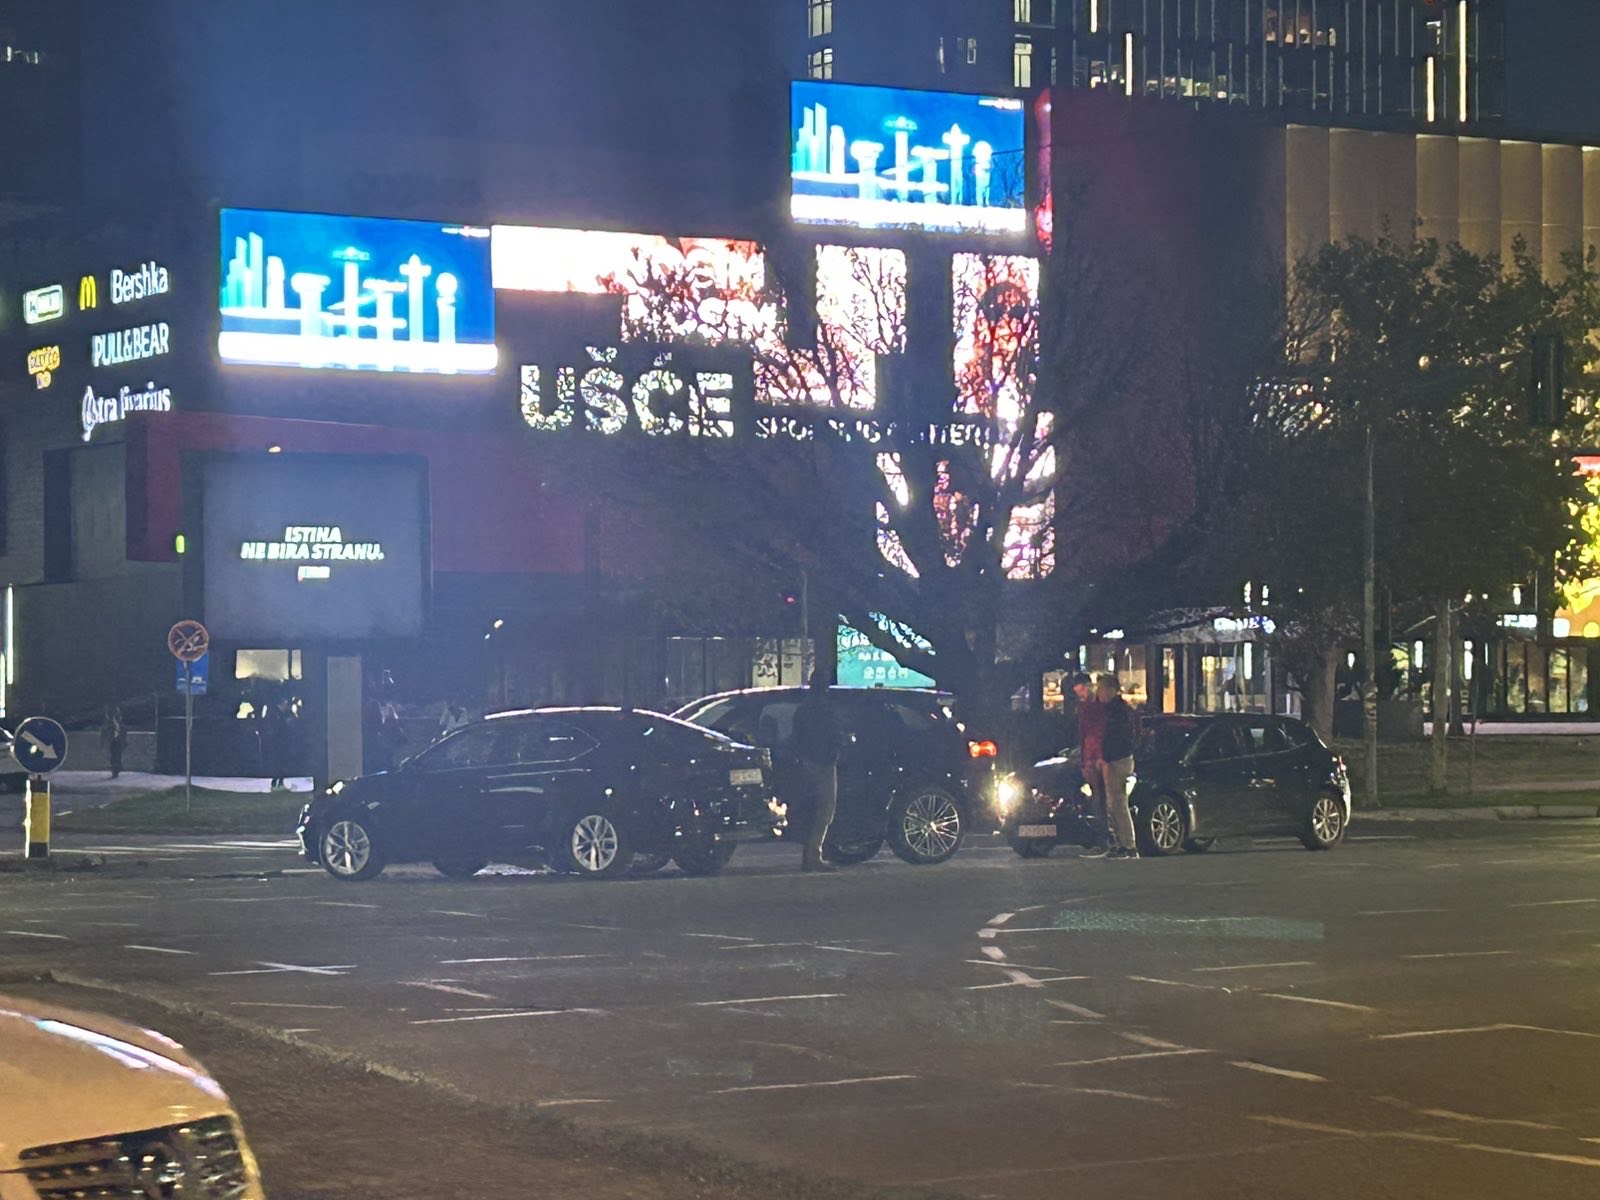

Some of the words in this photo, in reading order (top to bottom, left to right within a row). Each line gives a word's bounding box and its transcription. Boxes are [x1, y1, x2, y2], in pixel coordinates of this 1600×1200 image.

[111, 261, 169, 304] Bershka
[92, 323, 169, 367] PULL&BEAR
[520, 345, 734, 438] UŠĆE
[755, 416, 882, 443] SHONG
[285, 526, 342, 542] ISTINA
